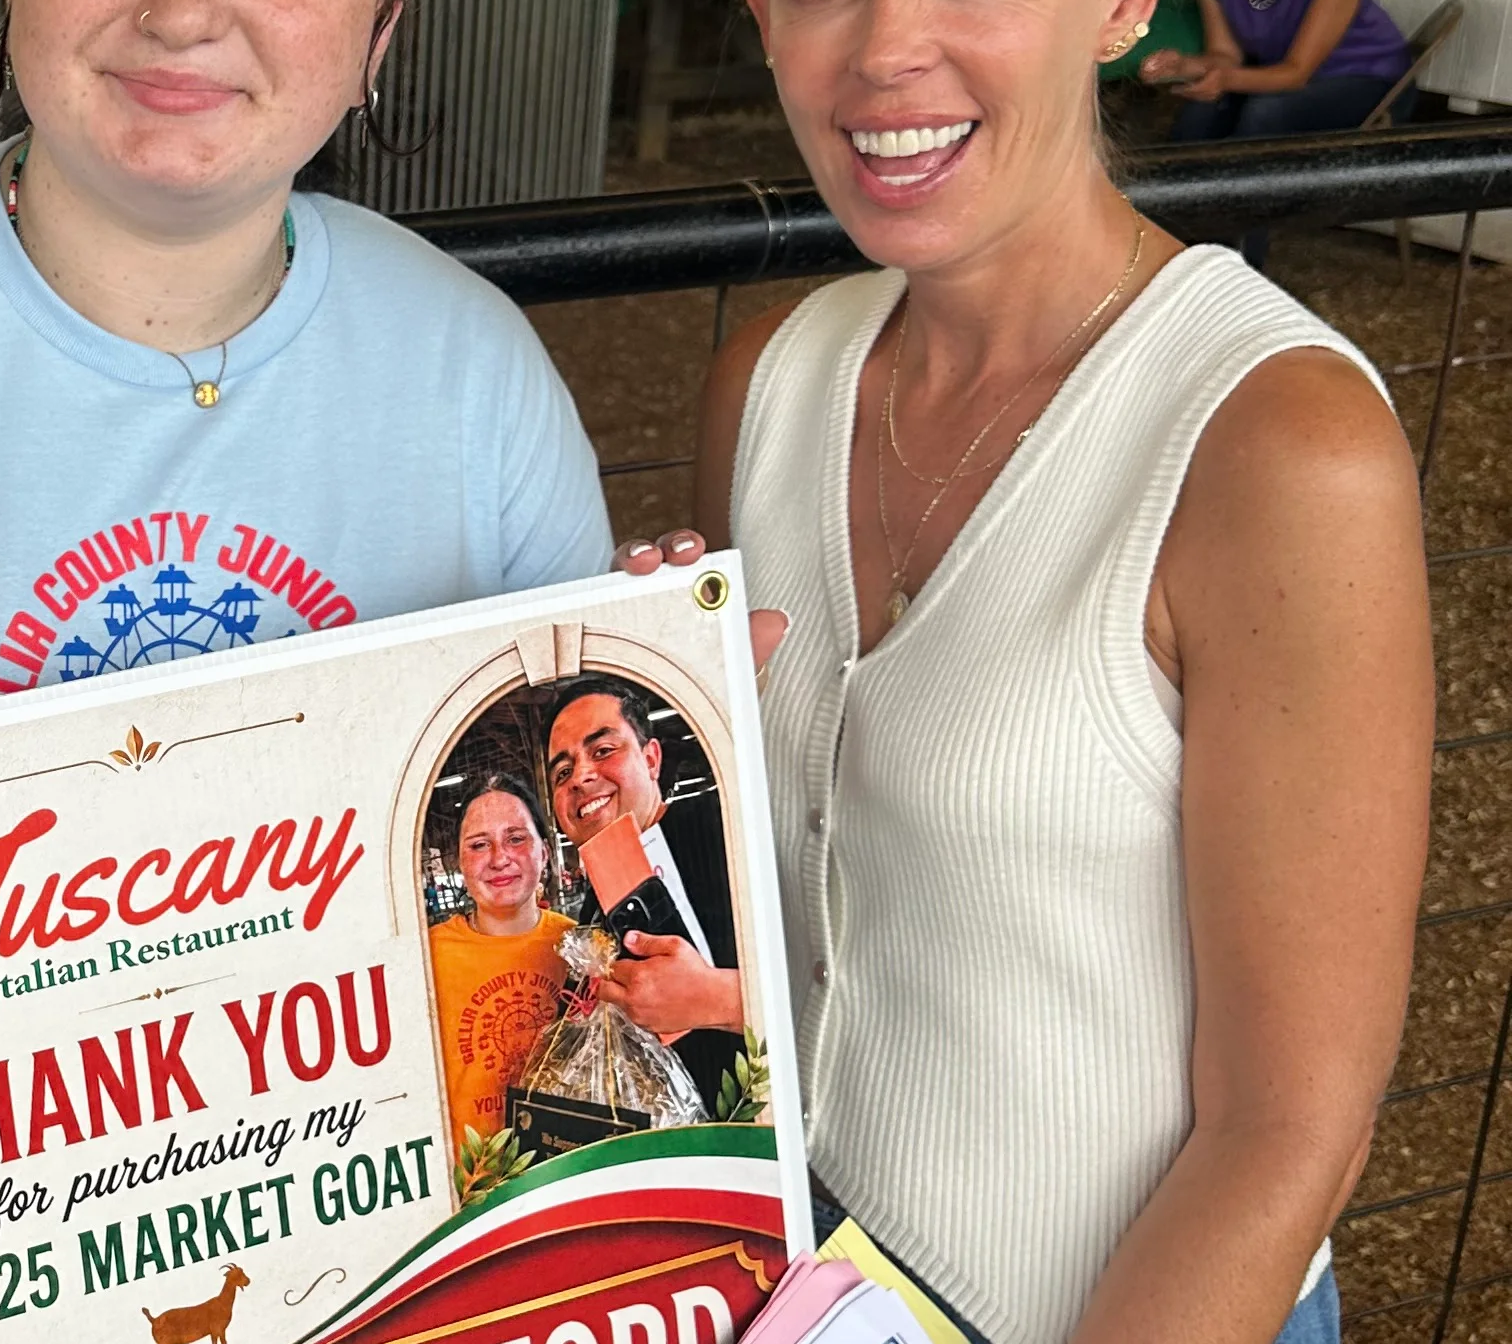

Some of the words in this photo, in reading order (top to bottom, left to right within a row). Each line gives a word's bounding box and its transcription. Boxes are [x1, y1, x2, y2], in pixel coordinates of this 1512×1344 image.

[33, 511, 211, 622] COUNTY
[217, 524, 358, 631] JUNIO
[105, 906, 295, 972] Restaurant
[470, 971, 527, 1007] COUNTY
[220, 963, 393, 1097] YOU
[62, 1115, 296, 1222] purchasing
[301, 1098, 366, 1148] my
[474, 1094, 507, 1115] YOU
[78, 1173, 295, 1297] MARKET
[312, 1136, 435, 1225] GOAT
